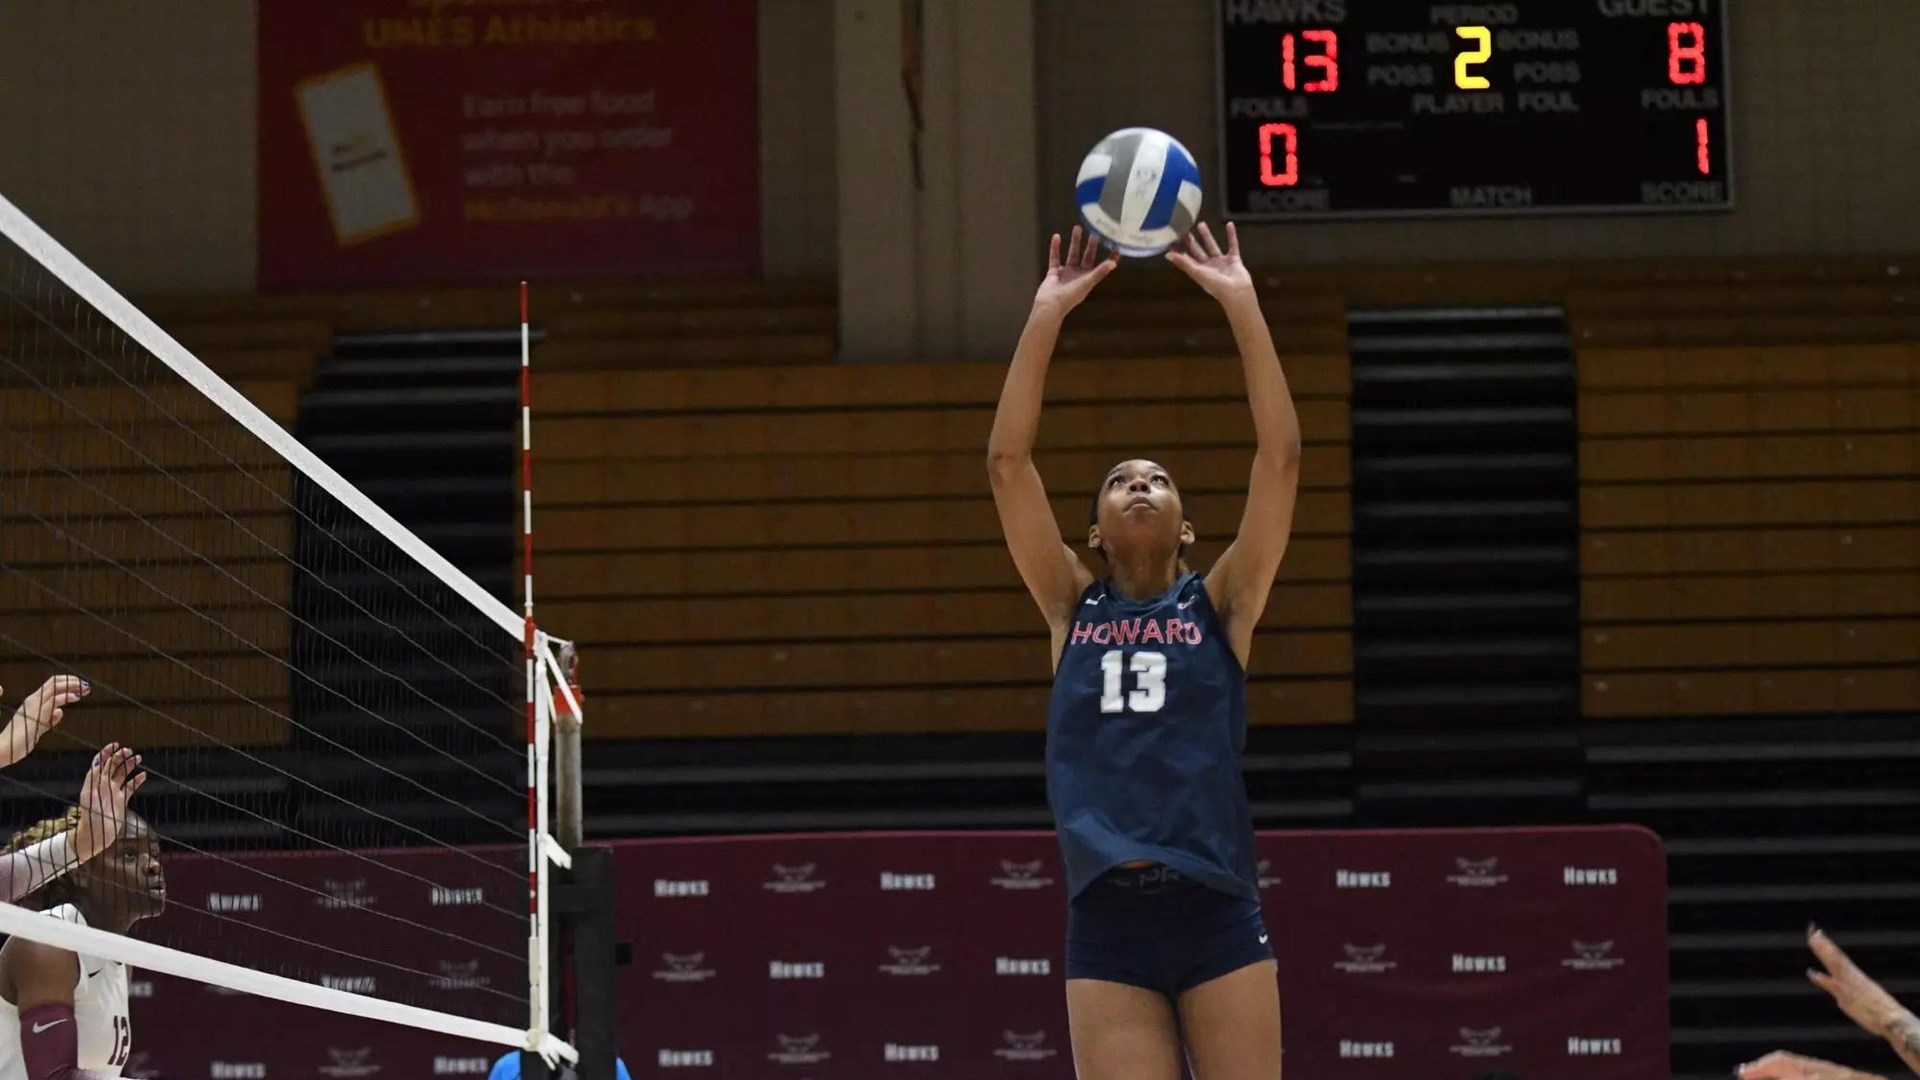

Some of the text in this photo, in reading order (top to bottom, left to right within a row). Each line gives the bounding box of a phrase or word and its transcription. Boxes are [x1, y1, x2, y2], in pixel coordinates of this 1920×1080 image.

[1226, 0, 1345, 23] HAWKS
[1430, 5, 1518, 25] PERIOD
[1365, 32, 1449, 53] BONUS
[1496, 30, 1580, 51] BONUS
[1282, 30, 1338, 92] 13
[1454, 26, 1491, 89] 2
[1668, 22, 1705, 85] 8
[1366, 63, 1435, 86] POSS
[1512, 61, 1582, 84] POSS
[1230, 97, 1308, 118] FOULS
[1412, 91, 1579, 114] PLAYER FOUL
[1641, 88, 1719, 110] FOULS
[1258, 122, 1298, 186] 0
[1696, 118, 1709, 175] 1
[1248, 190, 1328, 211] SCORE
[1450, 186, 1533, 207] MATCH
[1641, 181, 1720, 205] SCORE
[1070, 618, 1202, 645] HOWARD
[1100, 650, 1168, 713] 13
[108, 1015, 129, 1066] 12
